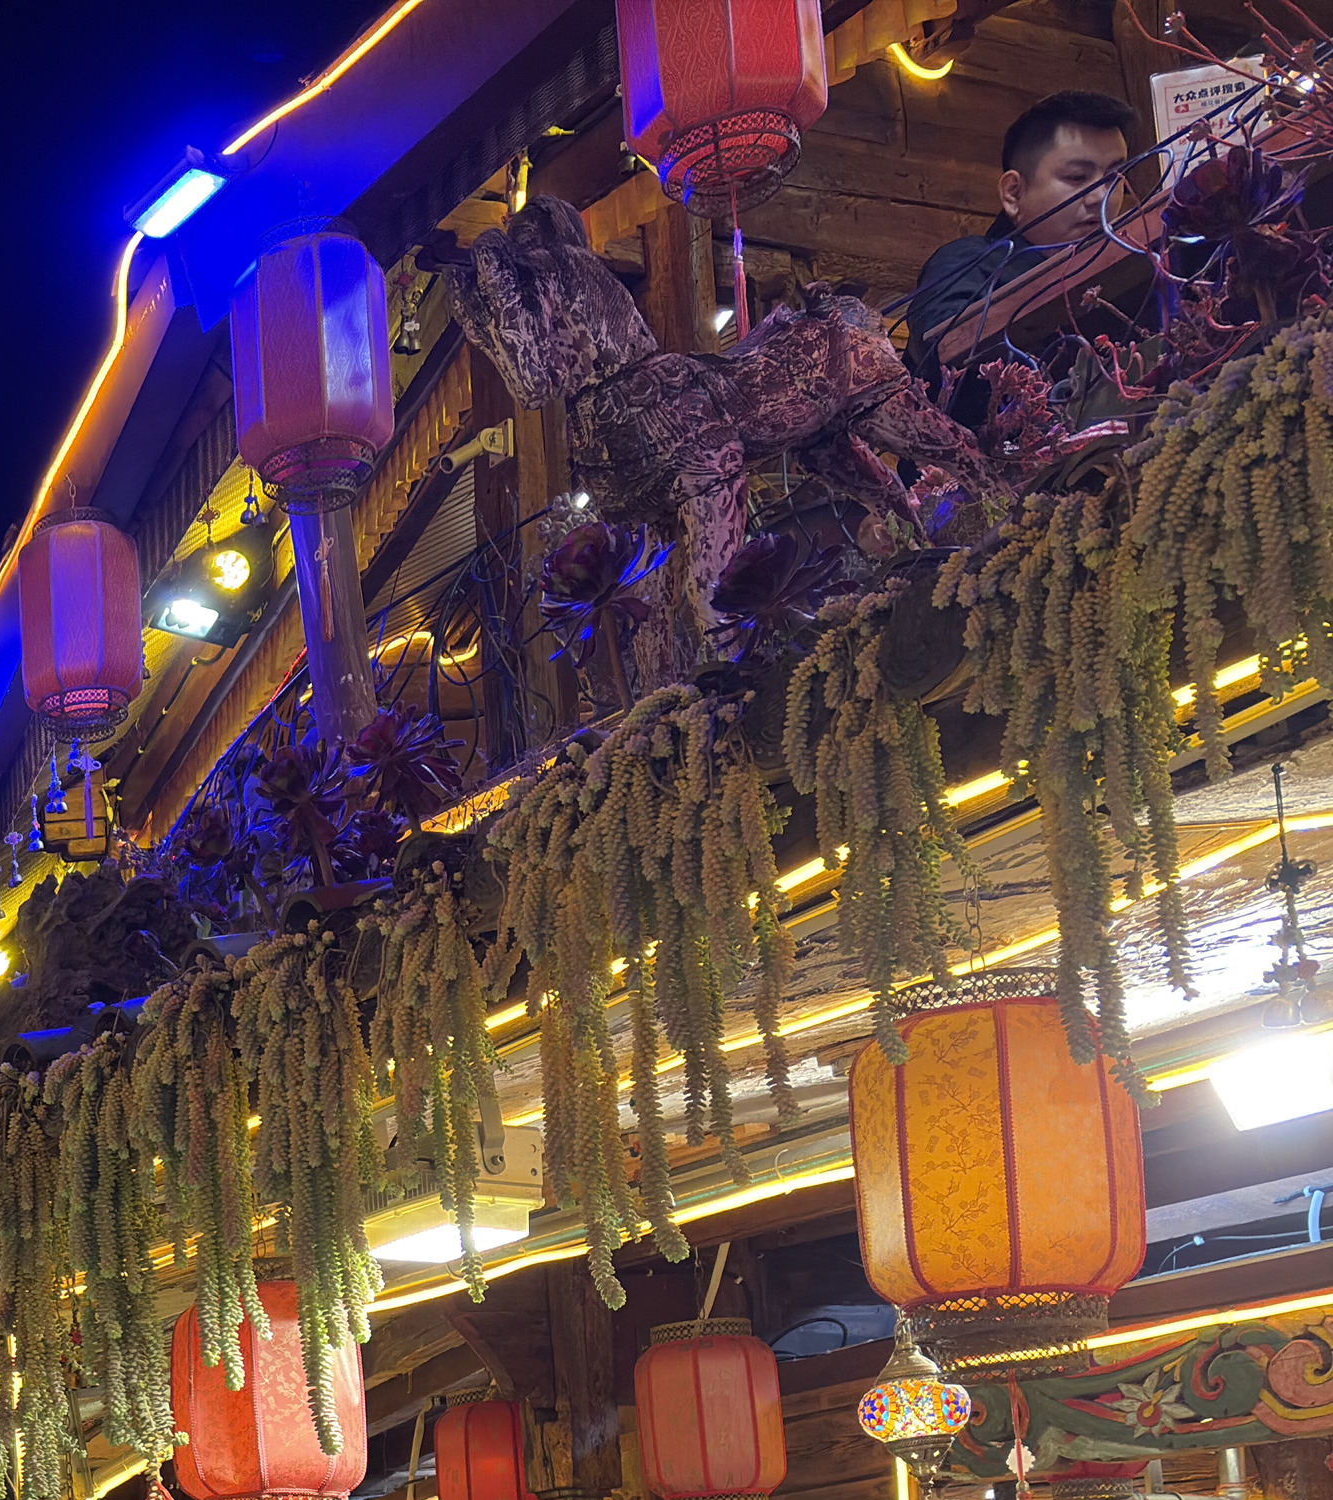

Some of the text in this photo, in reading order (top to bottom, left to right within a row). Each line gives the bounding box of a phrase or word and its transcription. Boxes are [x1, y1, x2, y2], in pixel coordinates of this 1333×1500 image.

[1173, 81, 1246, 104] 大众点评搜索
